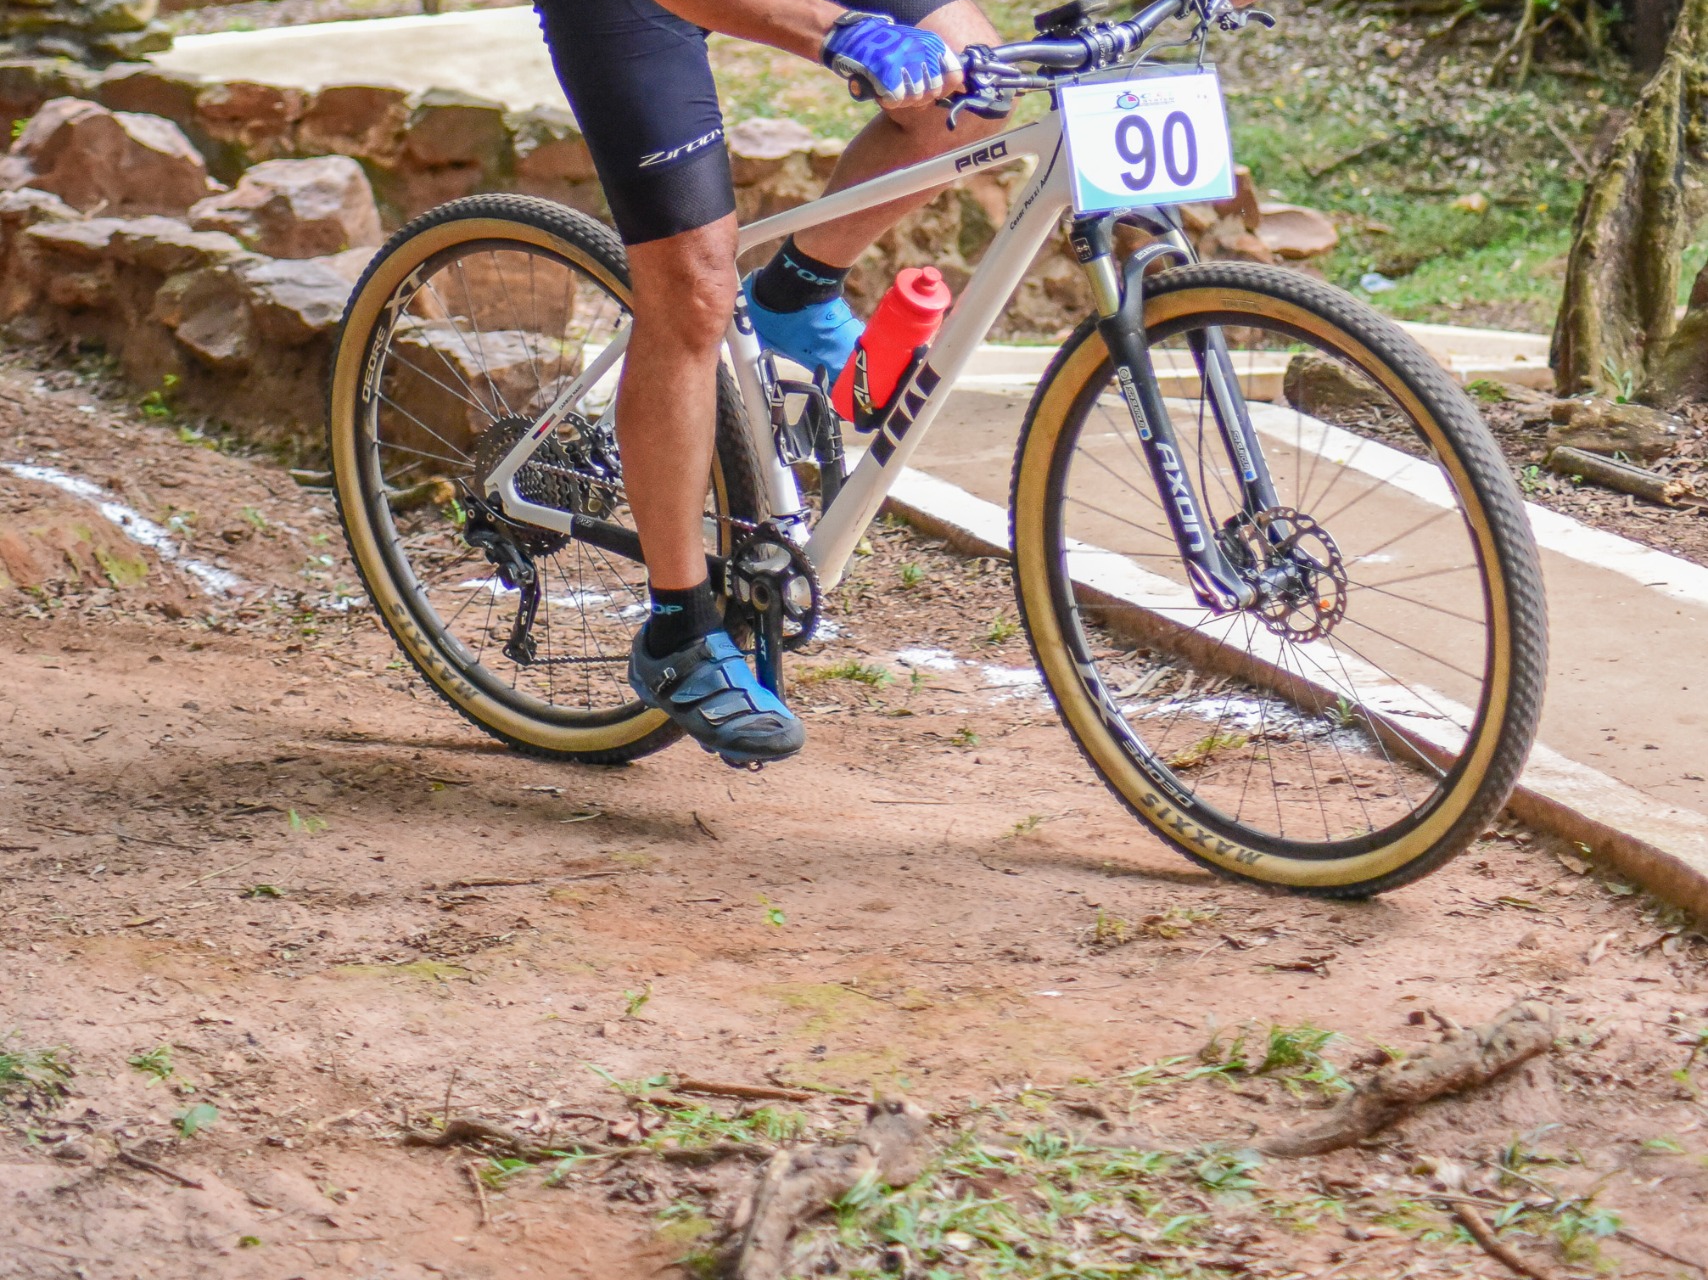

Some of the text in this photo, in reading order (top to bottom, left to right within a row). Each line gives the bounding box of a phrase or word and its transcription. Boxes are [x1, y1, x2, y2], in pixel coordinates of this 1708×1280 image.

[955, 140, 1008, 173] PRO
[1115, 111, 1198, 191] 90
[384, 262, 426, 327] XT
[782, 253, 837, 286] TOP
[361, 325, 387, 404] DEORE
[1155, 442, 1206, 552] AXON
[652, 604, 684, 615] OP
[389, 602, 480, 701] MAXXIS
[1123, 739, 1194, 809] DEORE
[1140, 792, 1263, 866] MAXXIS
